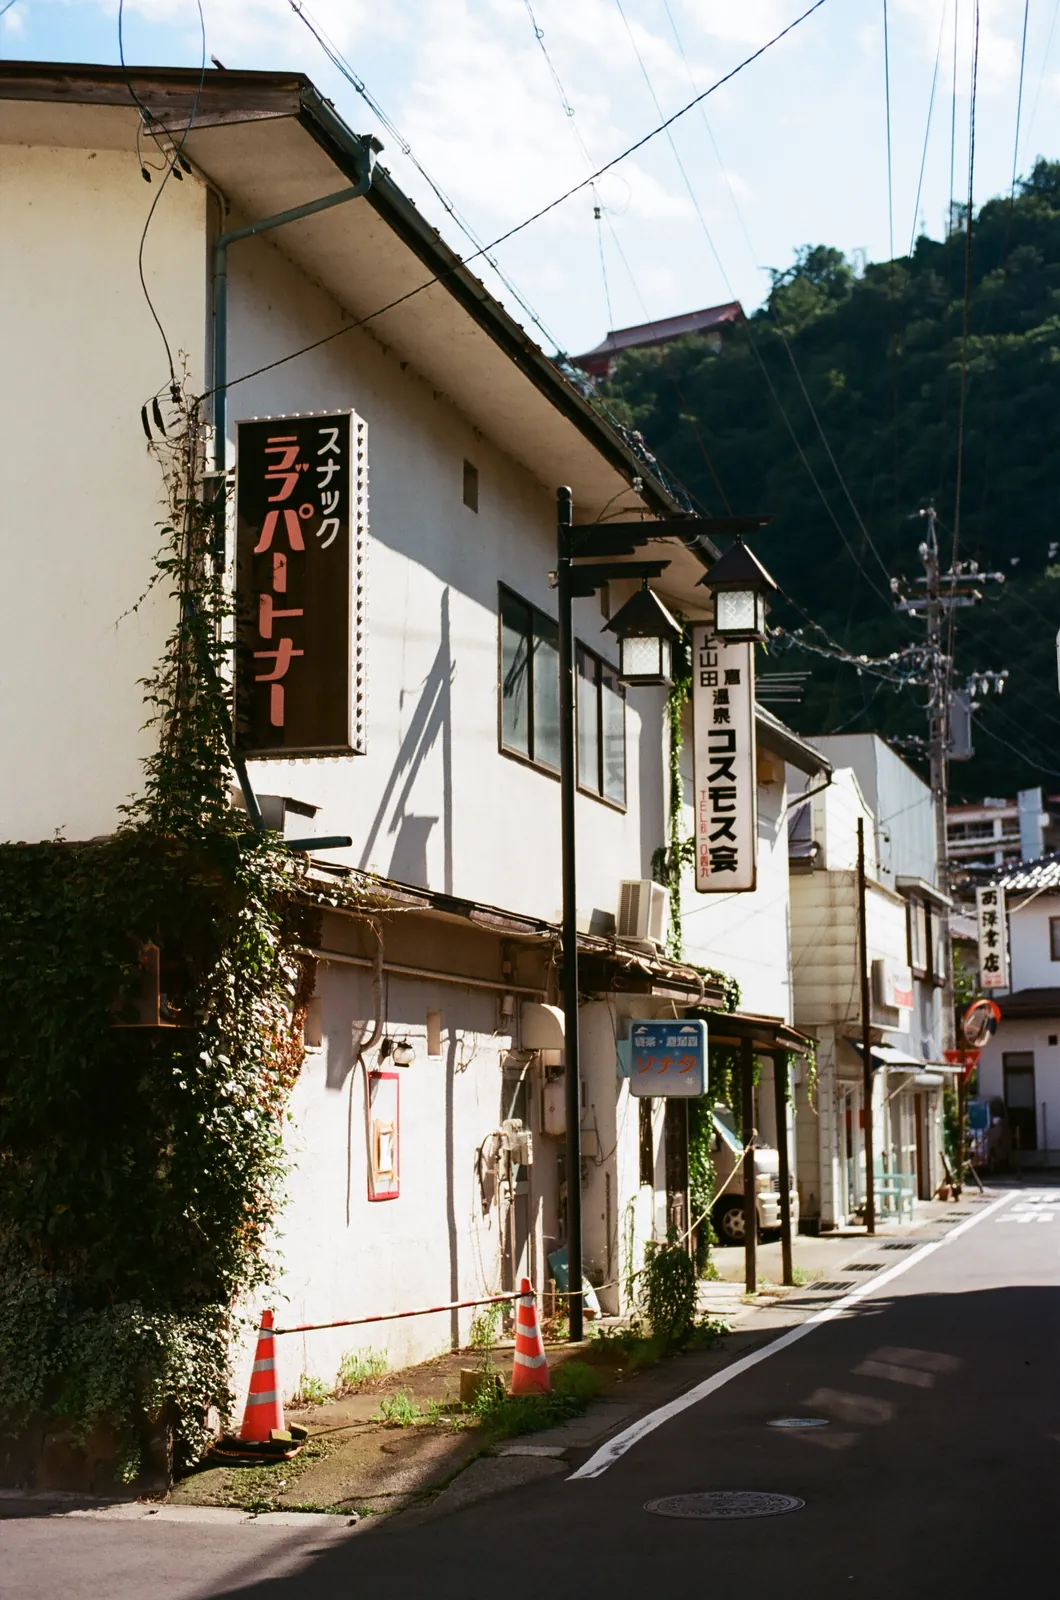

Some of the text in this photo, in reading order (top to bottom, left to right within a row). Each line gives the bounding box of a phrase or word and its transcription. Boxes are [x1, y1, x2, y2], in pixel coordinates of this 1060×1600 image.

[316, 427, 341, 549] スナック
[253, 435, 315, 727] ラブパートナー
[699, 635, 719, 687] 上山田
[636, 1054, 696, 1075] ソナタ
